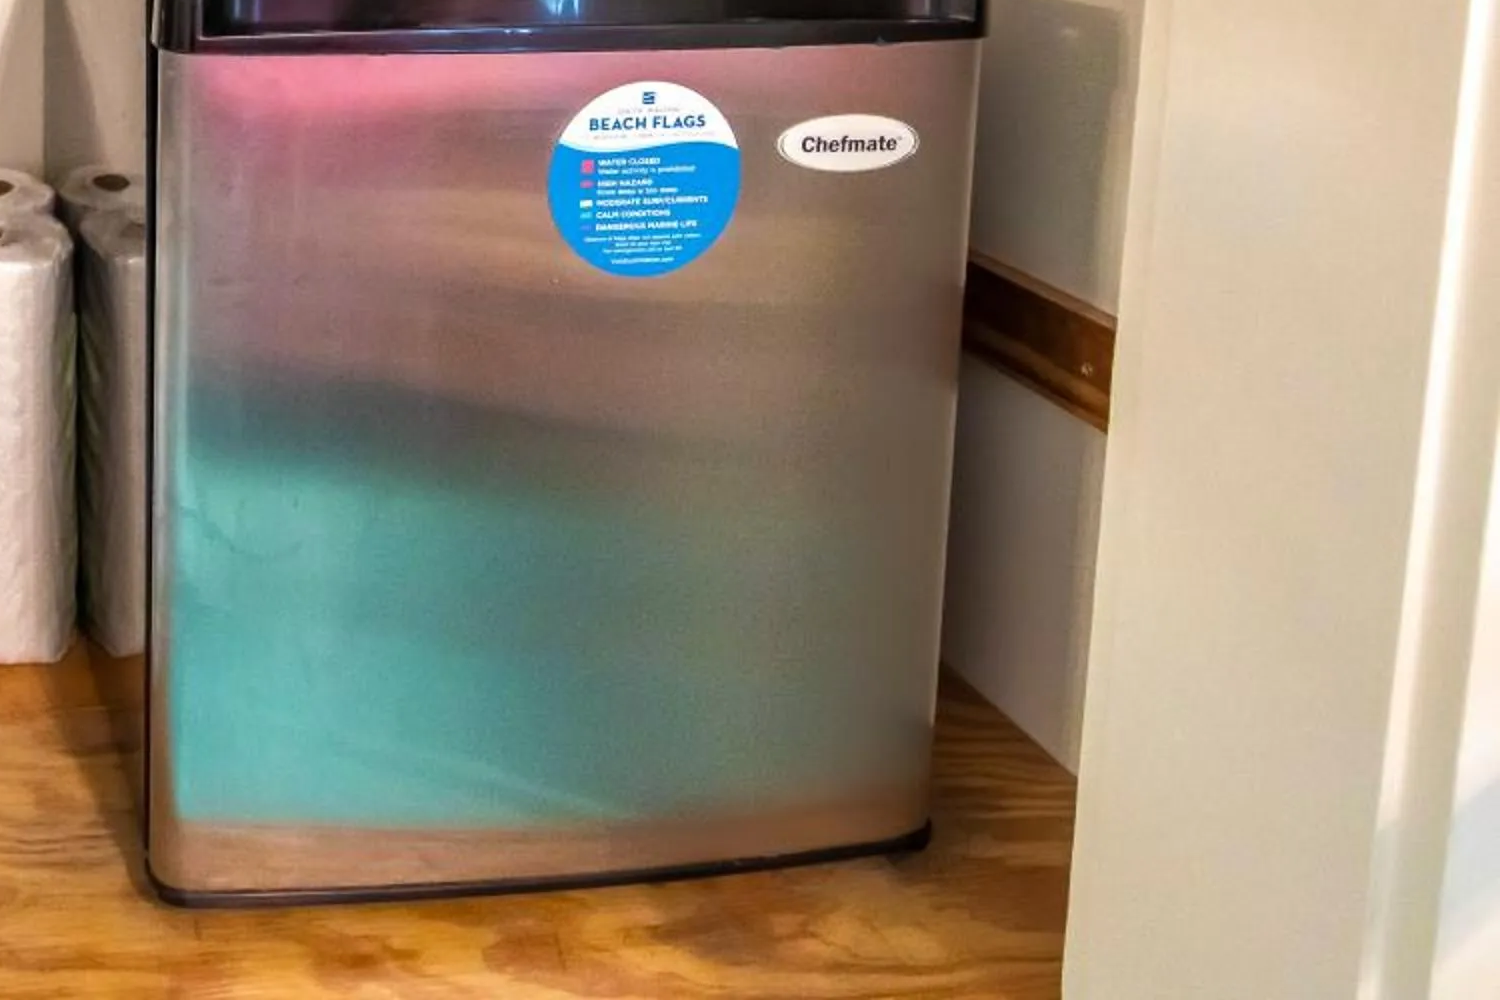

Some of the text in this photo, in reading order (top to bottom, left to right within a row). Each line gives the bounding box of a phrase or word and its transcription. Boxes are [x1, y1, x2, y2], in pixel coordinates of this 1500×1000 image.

[589, 114, 706, 131] BEACH FLAGS
[801, 135, 898, 153] Chefmate
[596, 211, 619, 219] CALM
